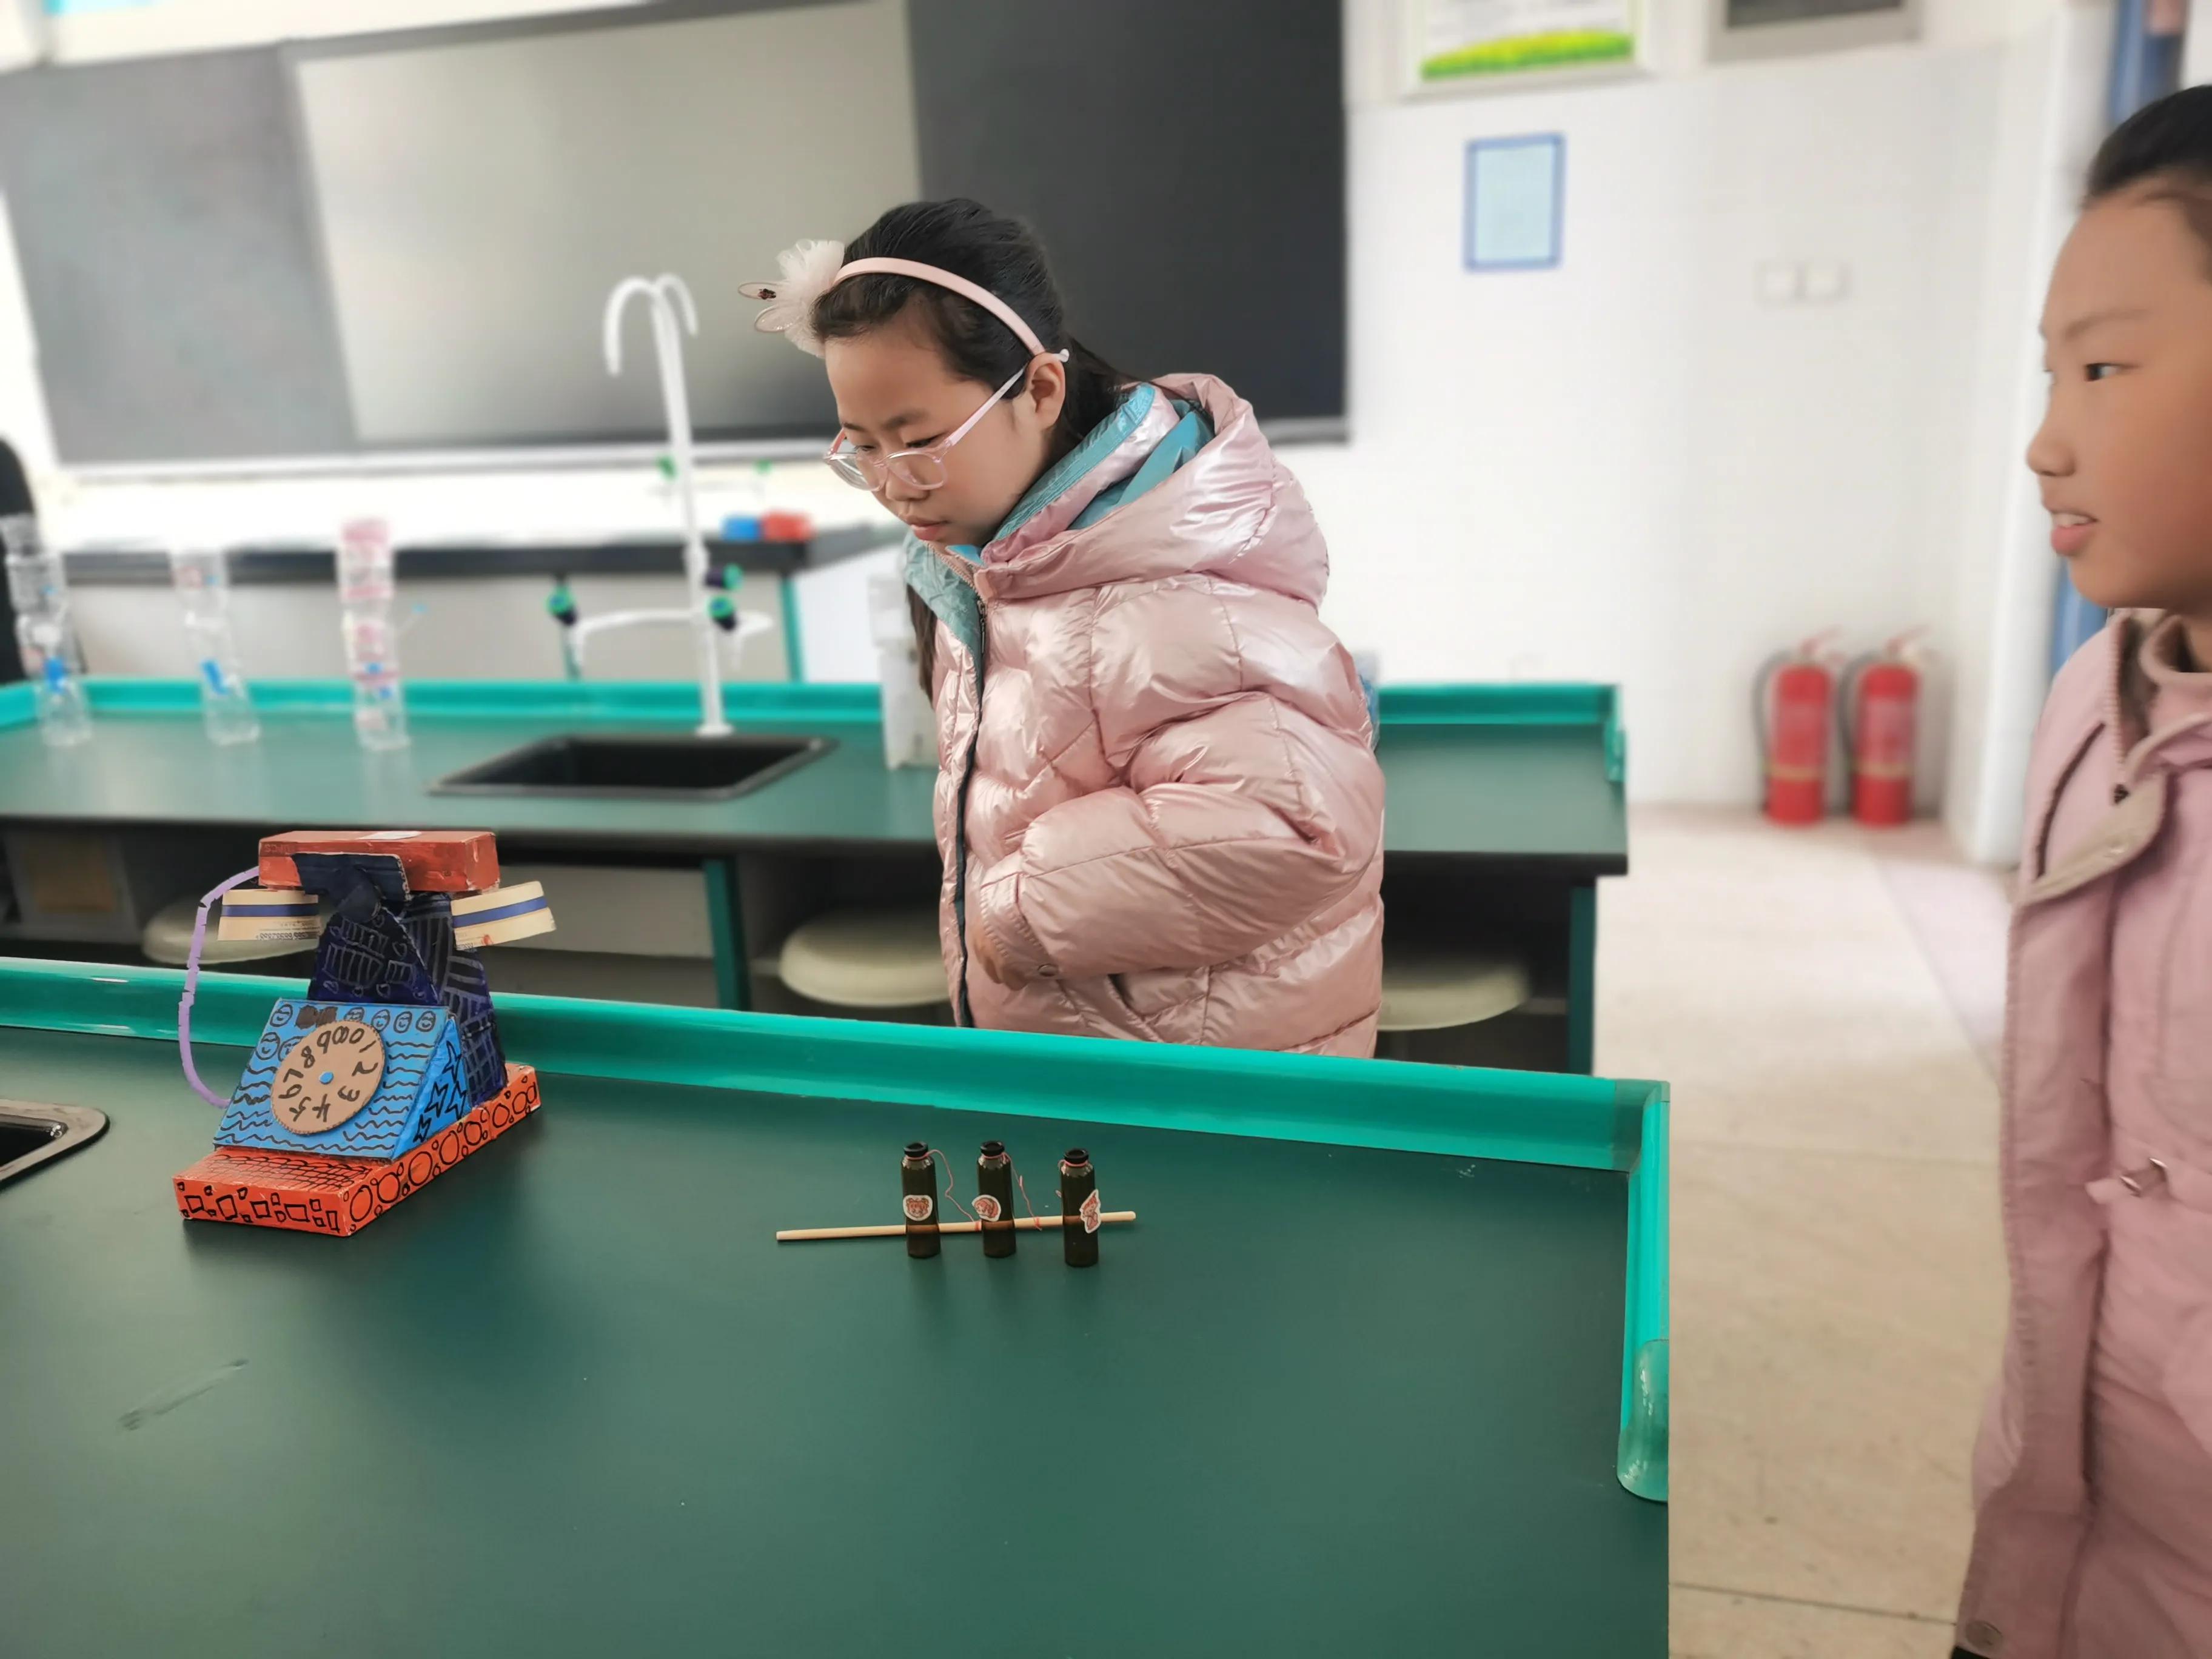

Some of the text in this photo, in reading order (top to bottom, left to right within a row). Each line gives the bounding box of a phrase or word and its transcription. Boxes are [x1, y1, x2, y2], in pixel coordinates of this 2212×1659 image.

[359, 1040, 377, 1053] 1
[301, 1045, 315, 1068] 8
[283, 1068, 304, 1083] 7
[352, 1061, 378, 1076] 2
[278, 1084, 302, 1099] 6
[337, 1085, 360, 1102] 3
[289, 1096, 311, 1122] 5
[312, 1094, 331, 1122] 4
